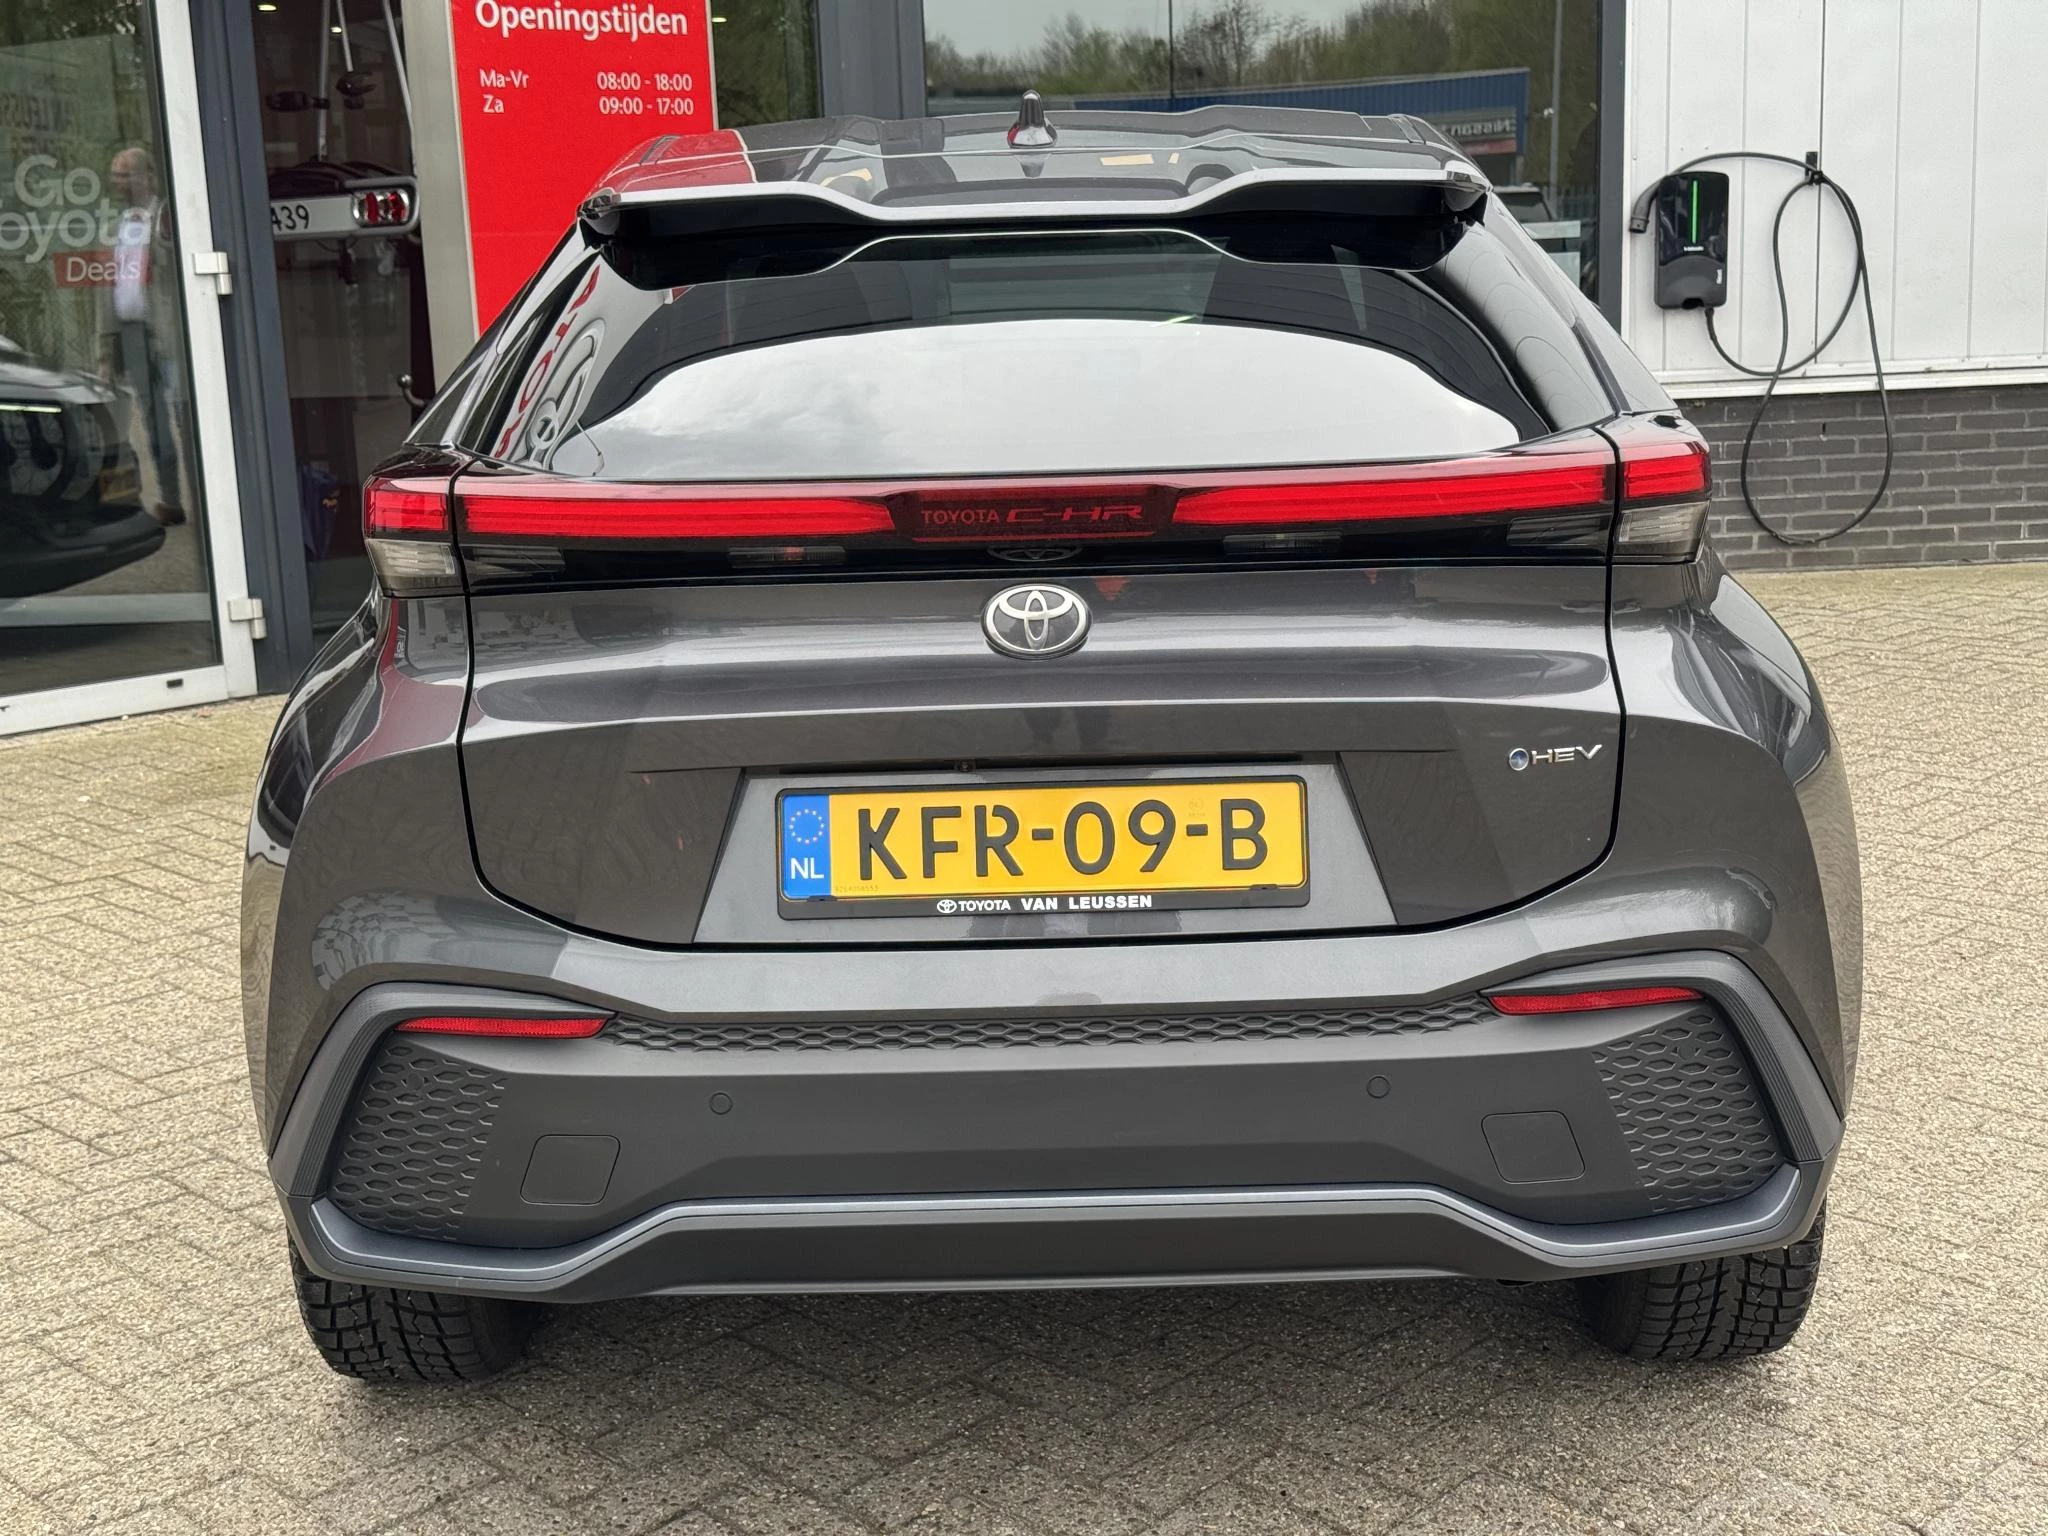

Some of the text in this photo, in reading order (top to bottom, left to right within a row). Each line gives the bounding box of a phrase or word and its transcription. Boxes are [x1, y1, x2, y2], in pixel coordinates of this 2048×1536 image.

[475, 0, 689, 42] Openingstijden
[479, 68, 530, 89] Ma-Vr
[596, 71, 641, 90] 08:00
[654, 73, 693, 92] 18:00
[482, 94, 505, 114] Za
[599, 97, 643, 115] 09:00
[656, 97, 694, 116] 17:00
[14, 154, 101, 207] Go
[0, 197, 151, 264] oyota
[66, 254, 141, 283] Deals
[921, 504, 1145, 525] TOYOTA C-HR
[1531, 743, 1603, 765] HEV
[857, 799, 1269, 881] KFR-09-B
[791, 857, 825, 879] NL
[958, 895, 1153, 912] TOYOTA VAN LEUSSEN
